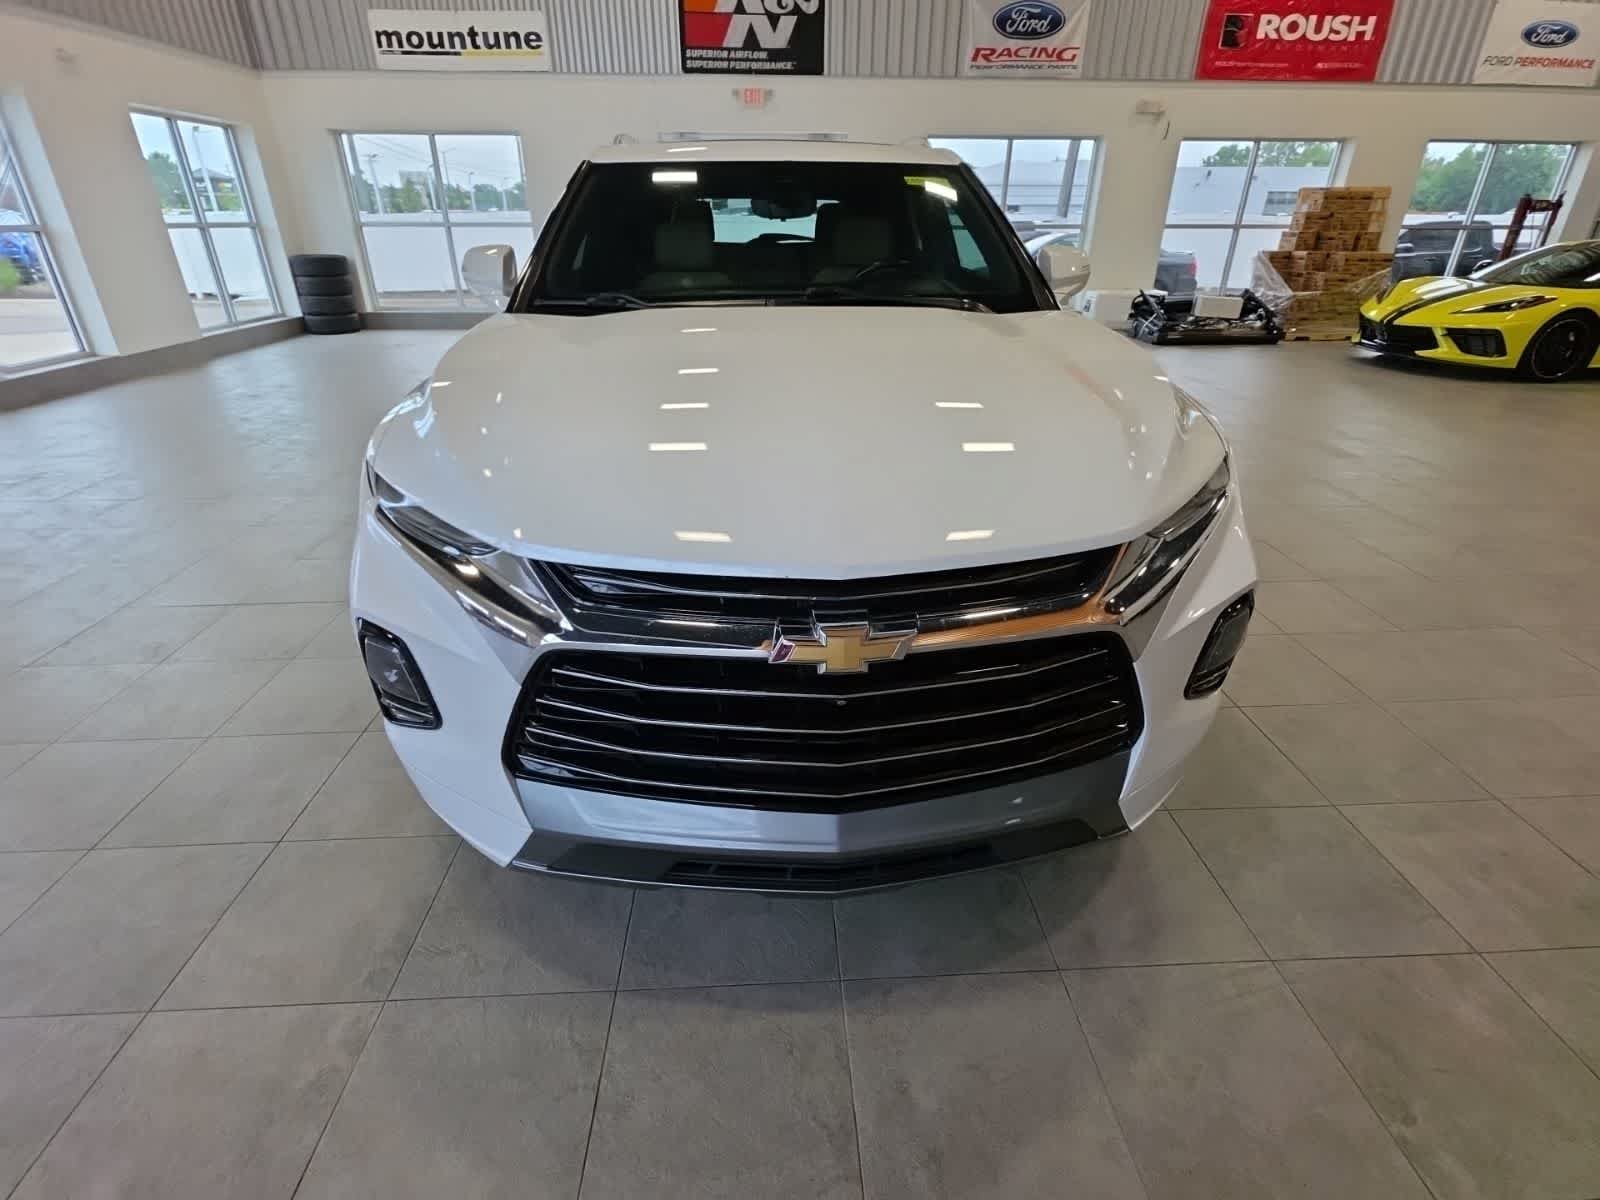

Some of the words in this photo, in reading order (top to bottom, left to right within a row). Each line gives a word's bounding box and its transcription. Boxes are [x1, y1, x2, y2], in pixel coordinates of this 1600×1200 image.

[1006, 6, 1053, 33] Ford
[1256, 13, 1377, 41] ROUSH
[375, 25, 543, 50] mountune
[1531, 24, 1569, 42] Ford
[686, 49, 728, 58] SUPERIOR
[971, 46, 1081, 63] RACING
[1483, 55, 1513, 66] FORD
[1515, 56, 1595, 69] PERFORMANCE
[686, 59, 728, 68] SUPERIOR
